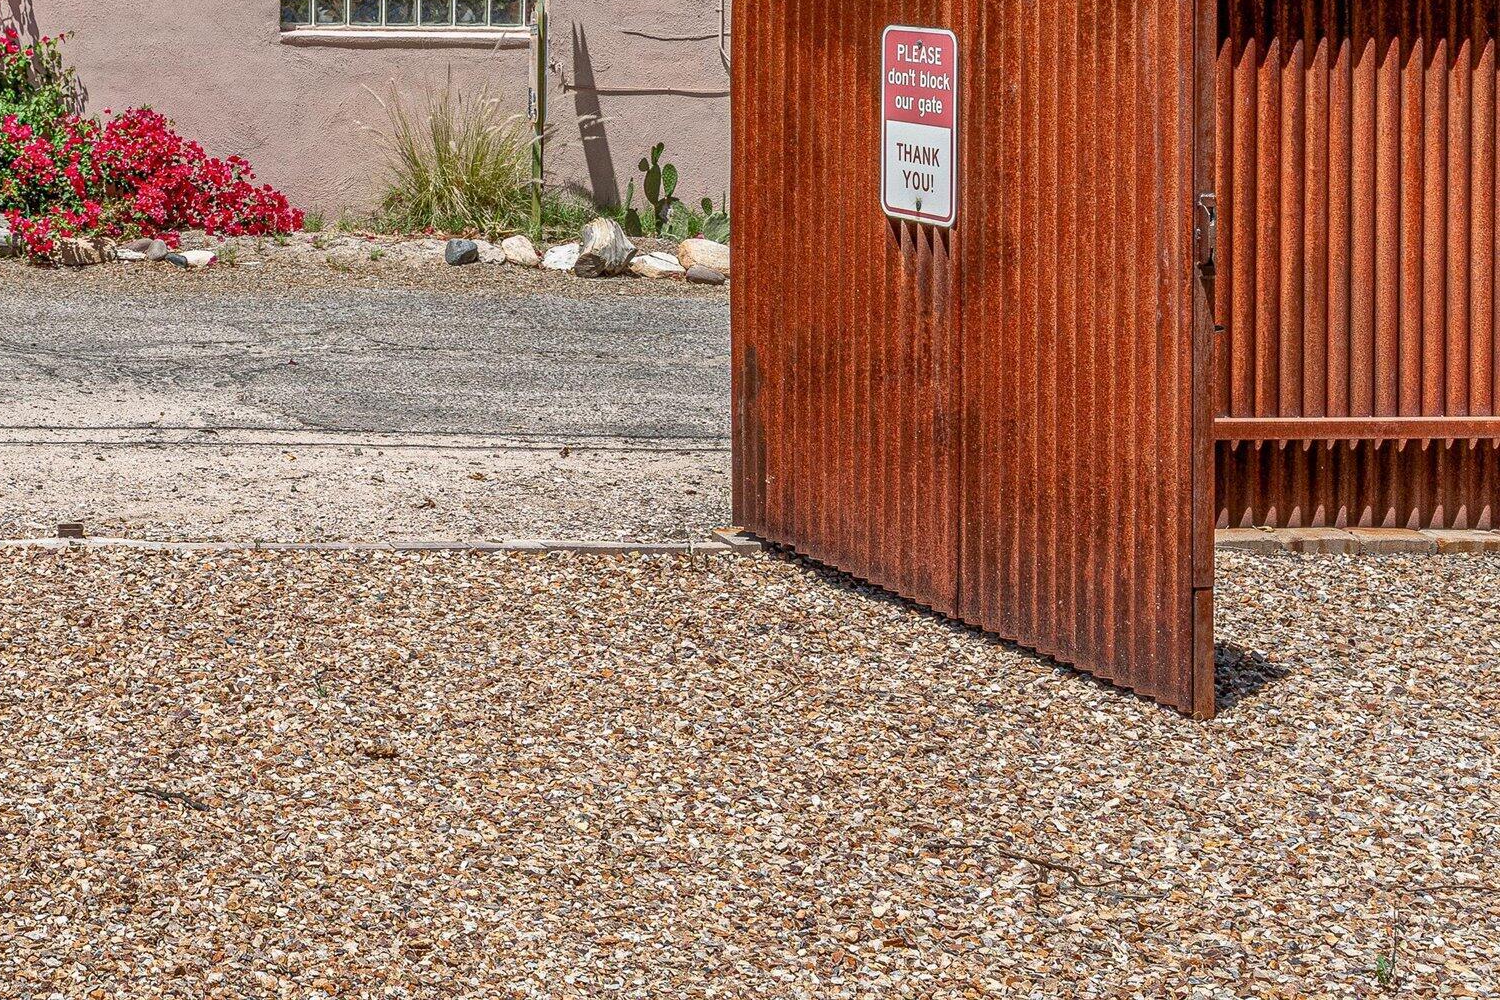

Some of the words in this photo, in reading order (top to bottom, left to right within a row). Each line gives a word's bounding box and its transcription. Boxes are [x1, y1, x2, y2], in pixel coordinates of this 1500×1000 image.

[897, 44, 942, 65] PLEASE
[888, 67, 916, 86] don't
[919, 70, 950, 91] block
[895, 95, 915, 110] our
[918, 96, 943, 117] gate
[897, 143, 939, 167] THANK
[903, 170, 933, 193] YOU!
